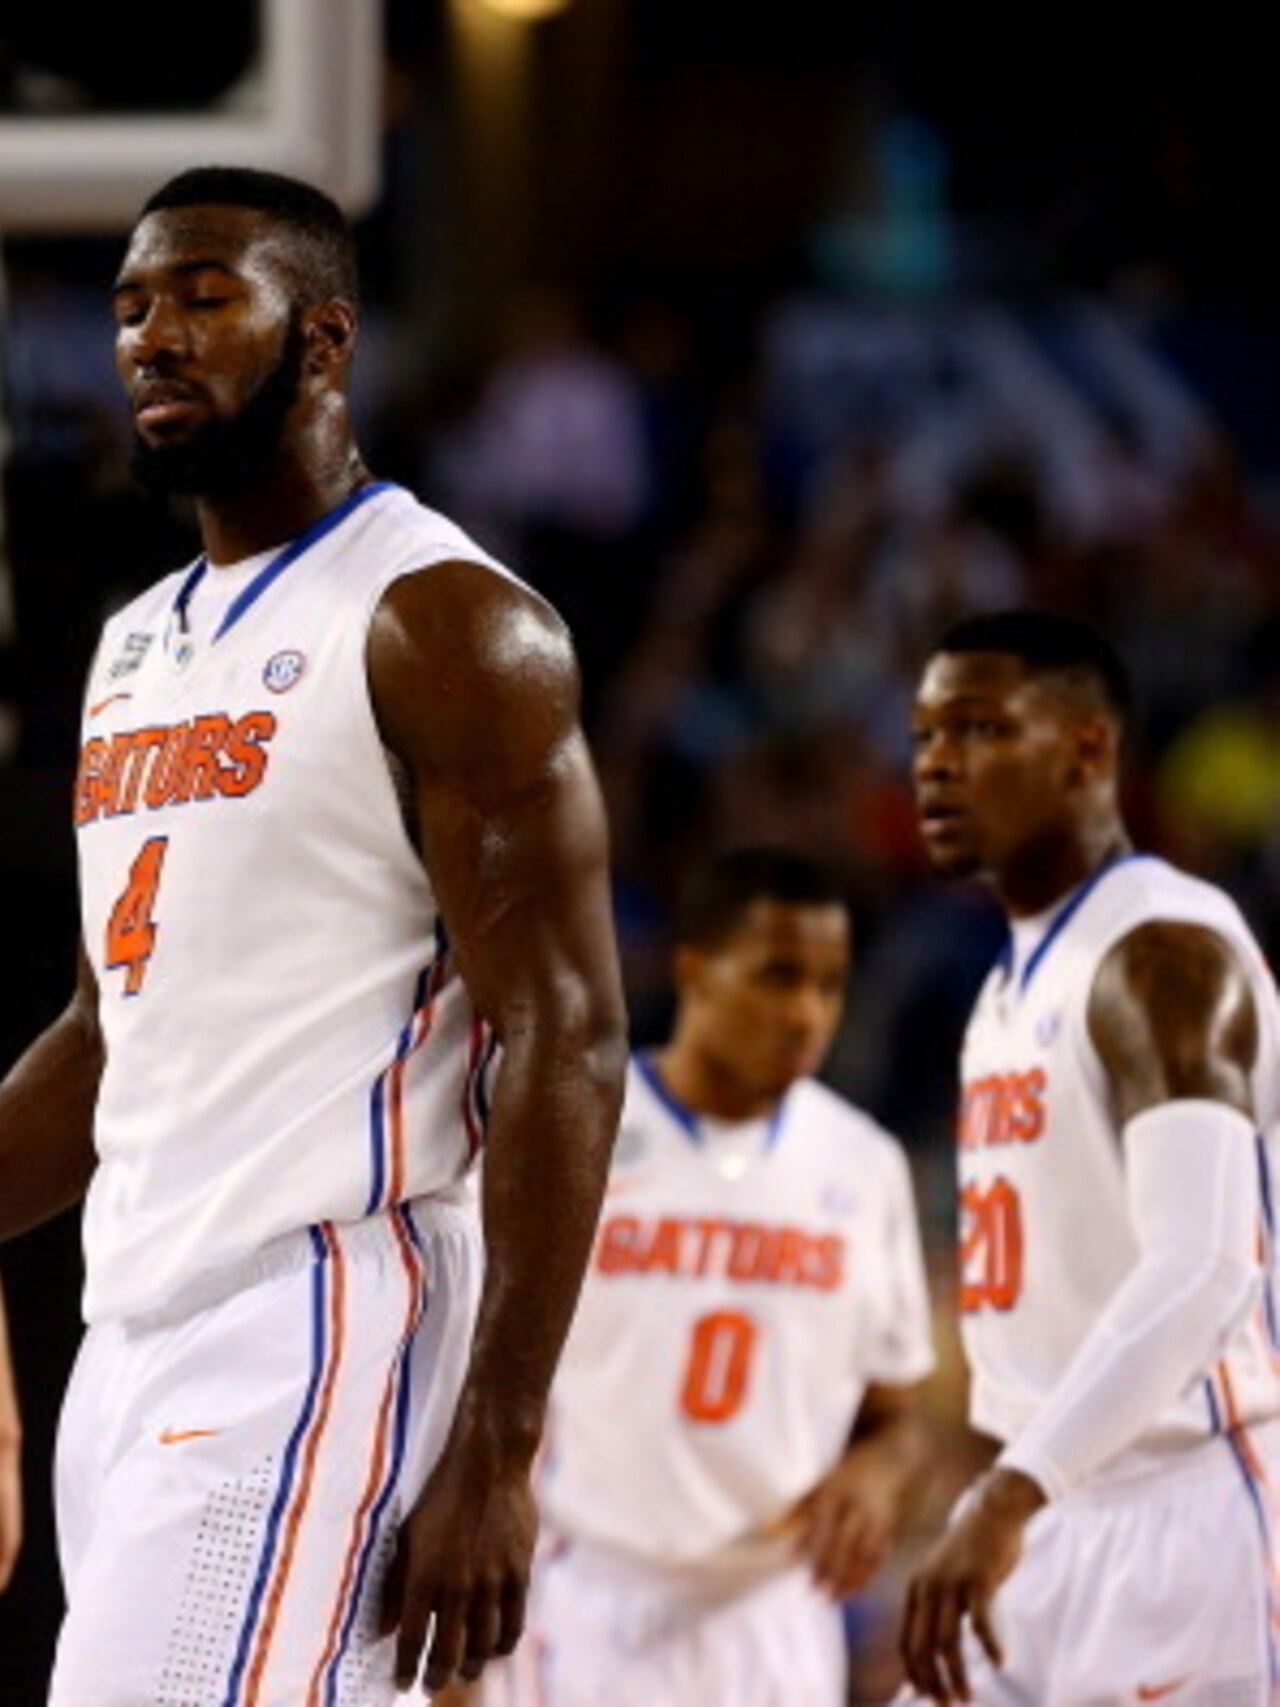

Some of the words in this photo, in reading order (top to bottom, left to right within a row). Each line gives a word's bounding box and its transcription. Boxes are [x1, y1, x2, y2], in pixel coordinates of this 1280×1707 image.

[75, 710, 277, 828] GATORS
[106, 835, 169, 996] 4
[597, 1215, 846, 1291] GATORS
[960, 1174, 1024, 1313] 20
[678, 1308, 757, 1425] 0
